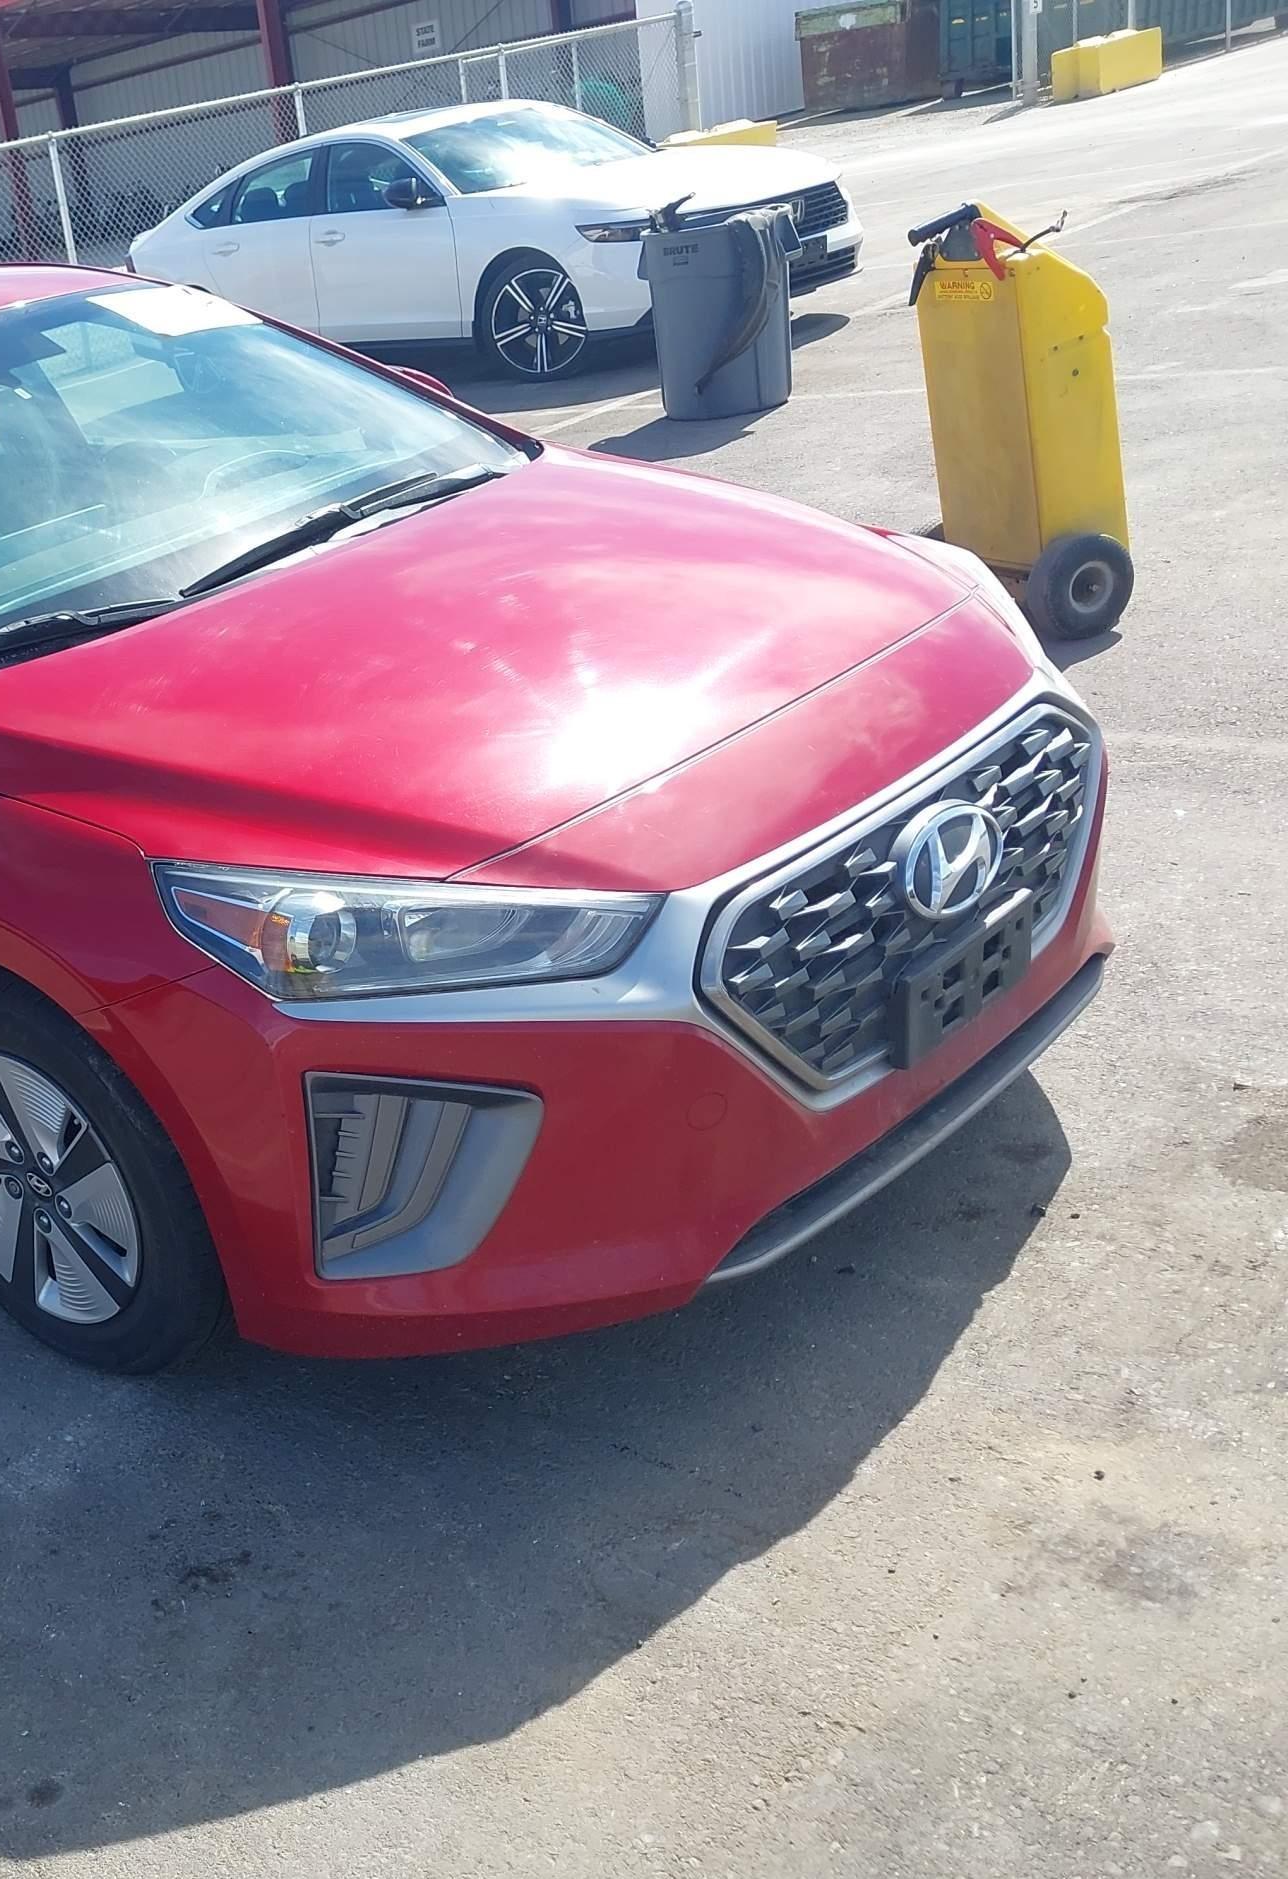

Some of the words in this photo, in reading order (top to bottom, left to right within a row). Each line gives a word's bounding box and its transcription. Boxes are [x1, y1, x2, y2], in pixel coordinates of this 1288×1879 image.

[415, 24, 434, 36] STATE
[417, 37, 436, 48] FARM
[663, 243, 700, 256] BRUTE
[939, 280, 976, 290] WARNING
